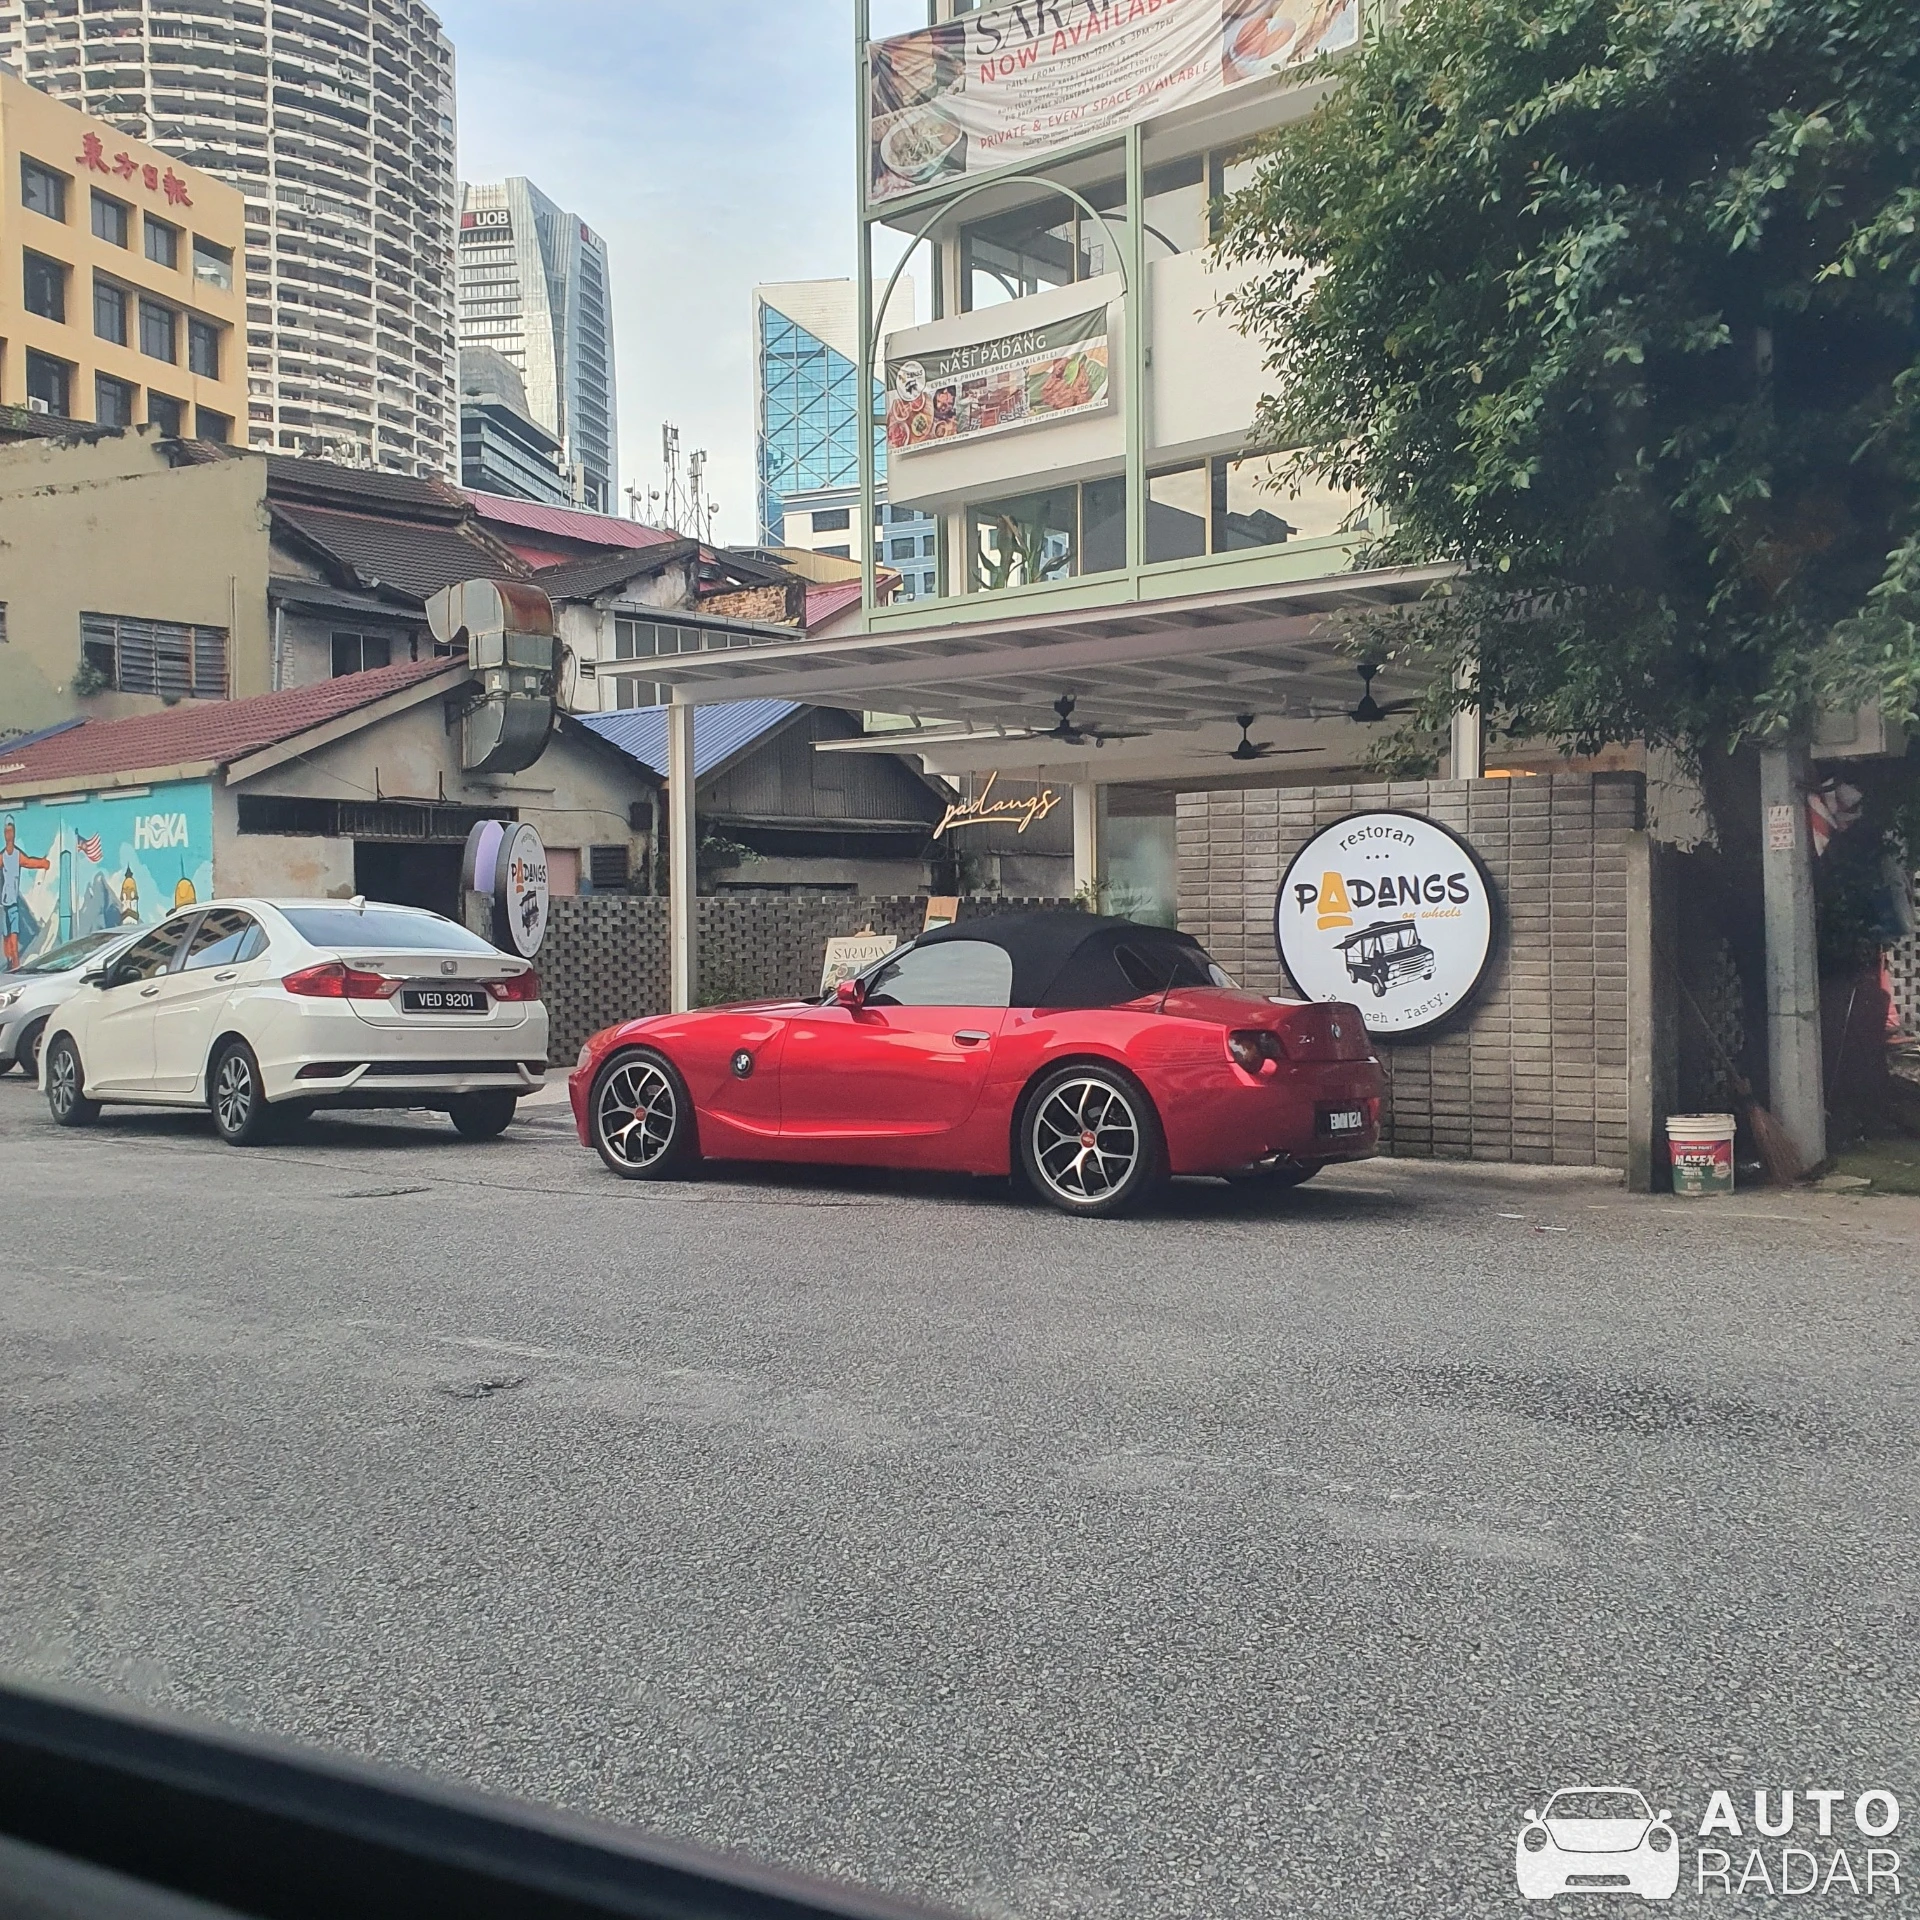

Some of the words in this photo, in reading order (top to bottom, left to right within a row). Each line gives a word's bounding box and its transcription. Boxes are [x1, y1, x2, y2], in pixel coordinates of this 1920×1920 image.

[980, 40, 1039, 84] NOW
[1051, 0, 1177, 56] AVAILAB
[980, 124, 1027, 149] PRIVATE
[1032, 119, 1041, 131] &
[1048, 104, 1088, 127] EVENT
[1093, 88, 1132, 111] SPACE
[1138, 60, 1209, 96] AVAILABLE
[75, 131, 194, 207] 東方日報
[476, 211, 509, 226] UOB
[940, 352, 975, 375] NASI
[981, 334, 1047, 364] PADANG
[930, 378, 951, 389] EVENT
[960, 369, 988, 381] PRIVATE
[991, 362, 1013, 374] SPACE
[933, 771, 1061, 839] padangs
[134, 812, 189, 850] HOKA
[1339, 825, 1415, 851] restoran
[511, 856, 546, 894] PADANGS
[1294, 871, 1470, 931] PADANGS
[1401, 911, 1416, 920] on
[1421, 906, 1463, 919] wheels
[418, 993, 441, 1007] VED
[446, 993, 474, 1007] 9201
[1364, 1011, 1388, 1023] ceh
[1404, 993, 1443, 1019] Tasty
